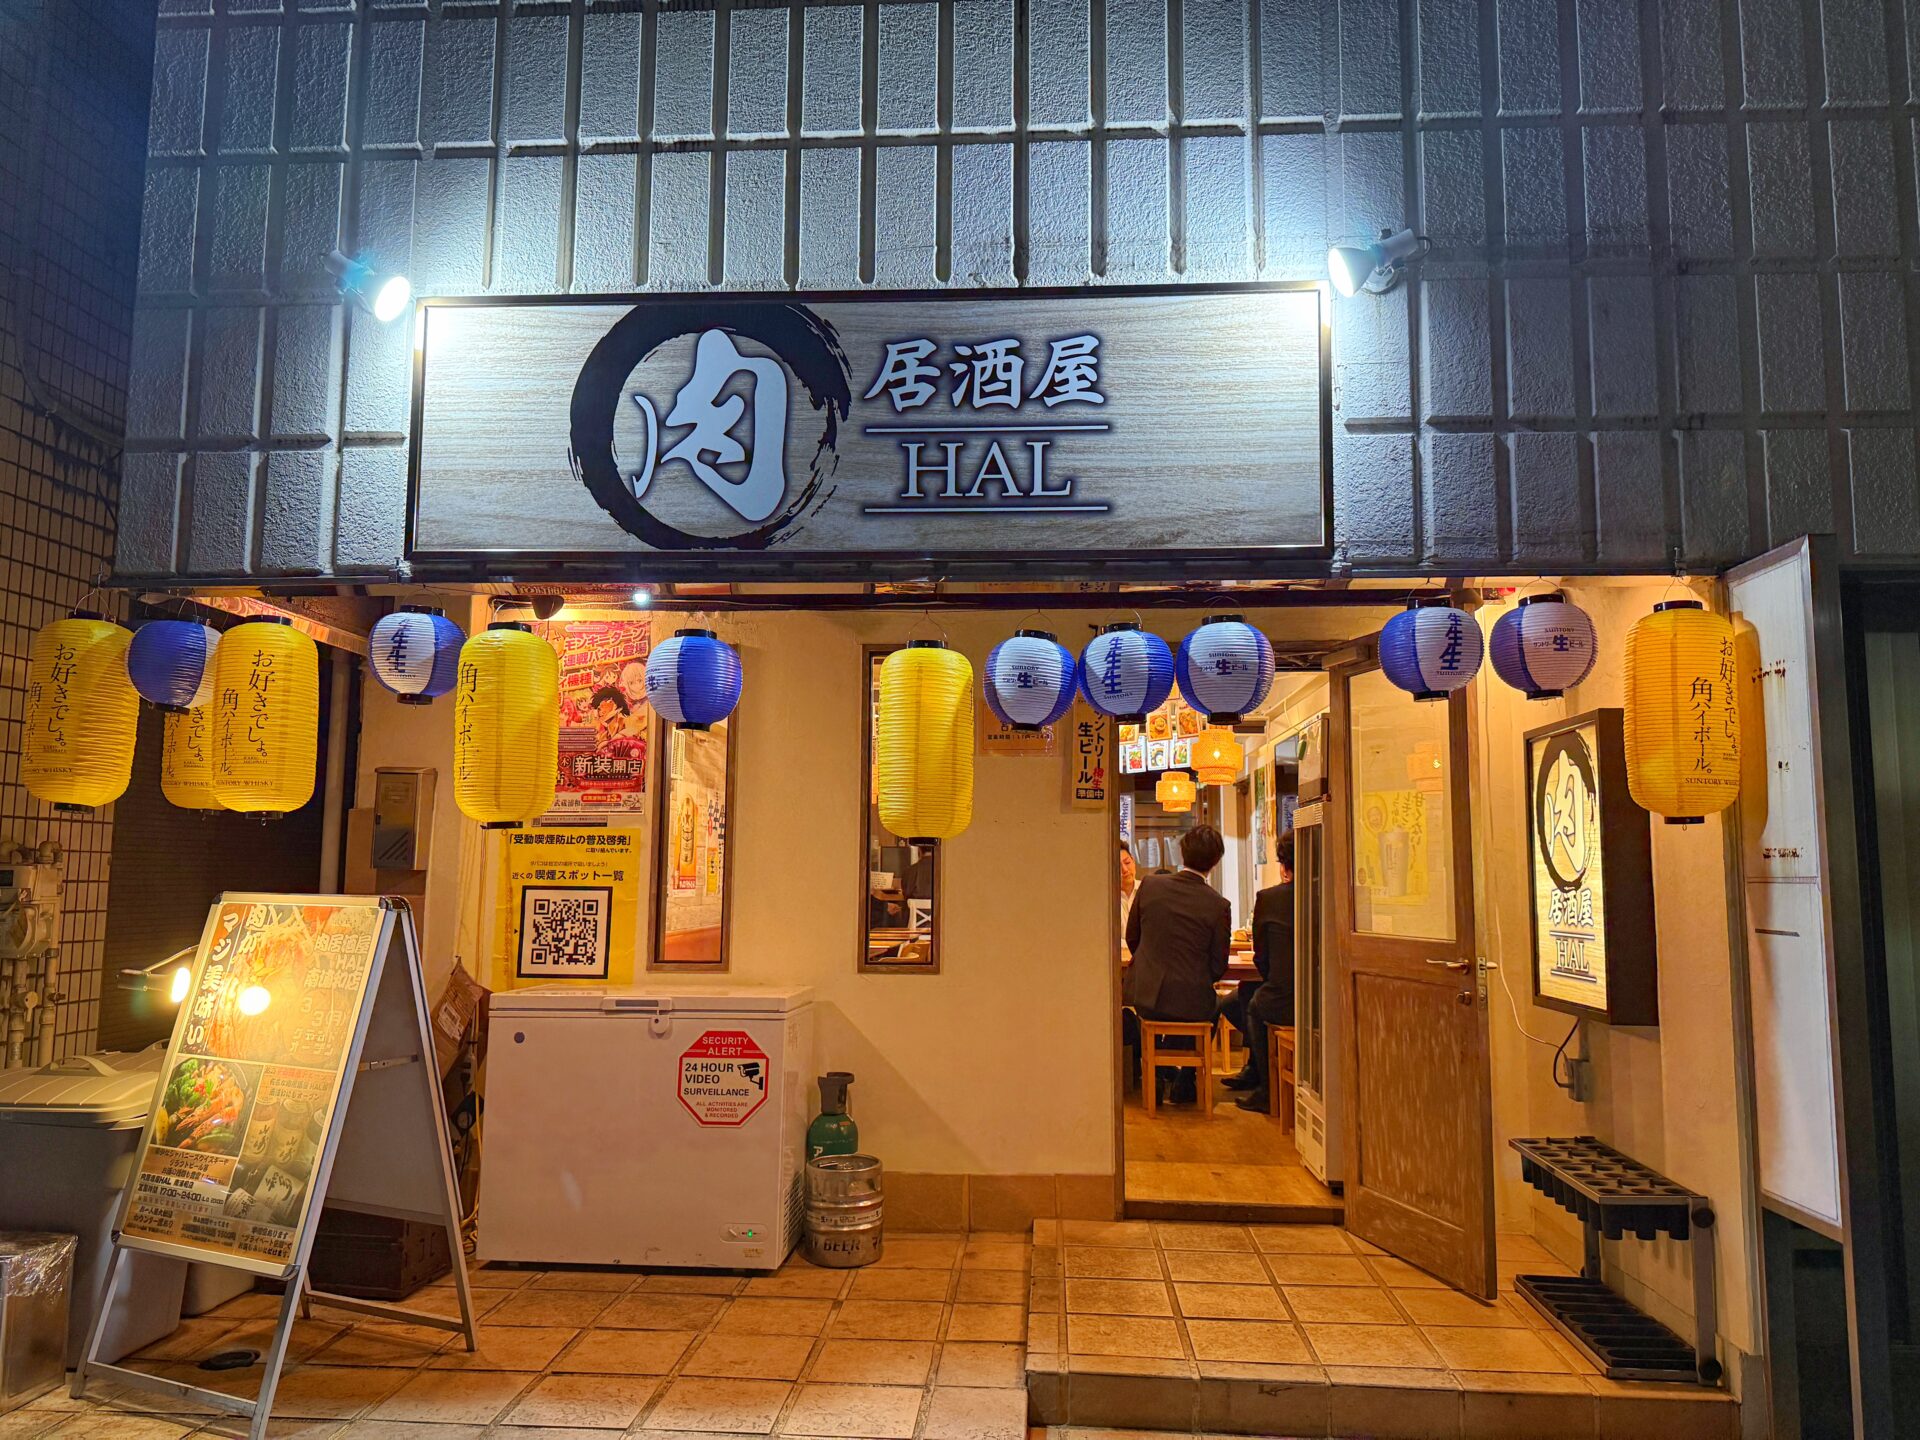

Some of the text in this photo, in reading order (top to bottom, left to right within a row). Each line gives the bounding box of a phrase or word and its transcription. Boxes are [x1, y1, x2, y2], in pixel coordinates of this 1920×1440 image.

[865, 335, 1106, 413] 居酒屋
[631, 329, 787, 522] 肉
[900, 441, 1073, 497] HAL
[47, 643, 78, 747] お好きでしょ。
[248, 649, 276, 757] お好きでしょ。
[220, 687, 239, 776] 角ハイボール。
[1689, 676, 1713, 774] 角ハイボール。
[574, 755, 642, 775] 新装開店
[1078, 722, 1094, 784] 生ビール
[1545, 749, 1586, 873] 肉
[509, 833, 632, 846] 「受動喫煙防止の普及啓発」
[1548, 889, 1594, 926] 居酒屋
[314, 933, 371, 954] 肉居酒屋
[335, 954, 364, 970] HAL
[1555, 938, 1590, 972] HAL
[187, 913, 238, 1045] マジ美味い
[702, 1036, 749, 1045] SECURITY
[707, 1047, 743, 1056] ALERT
[685, 1062, 734, 1073] 24 HOUR
[685, 1074, 720, 1084] VIDEO
[683, 1087, 750, 1097] SURVEILLANCE
